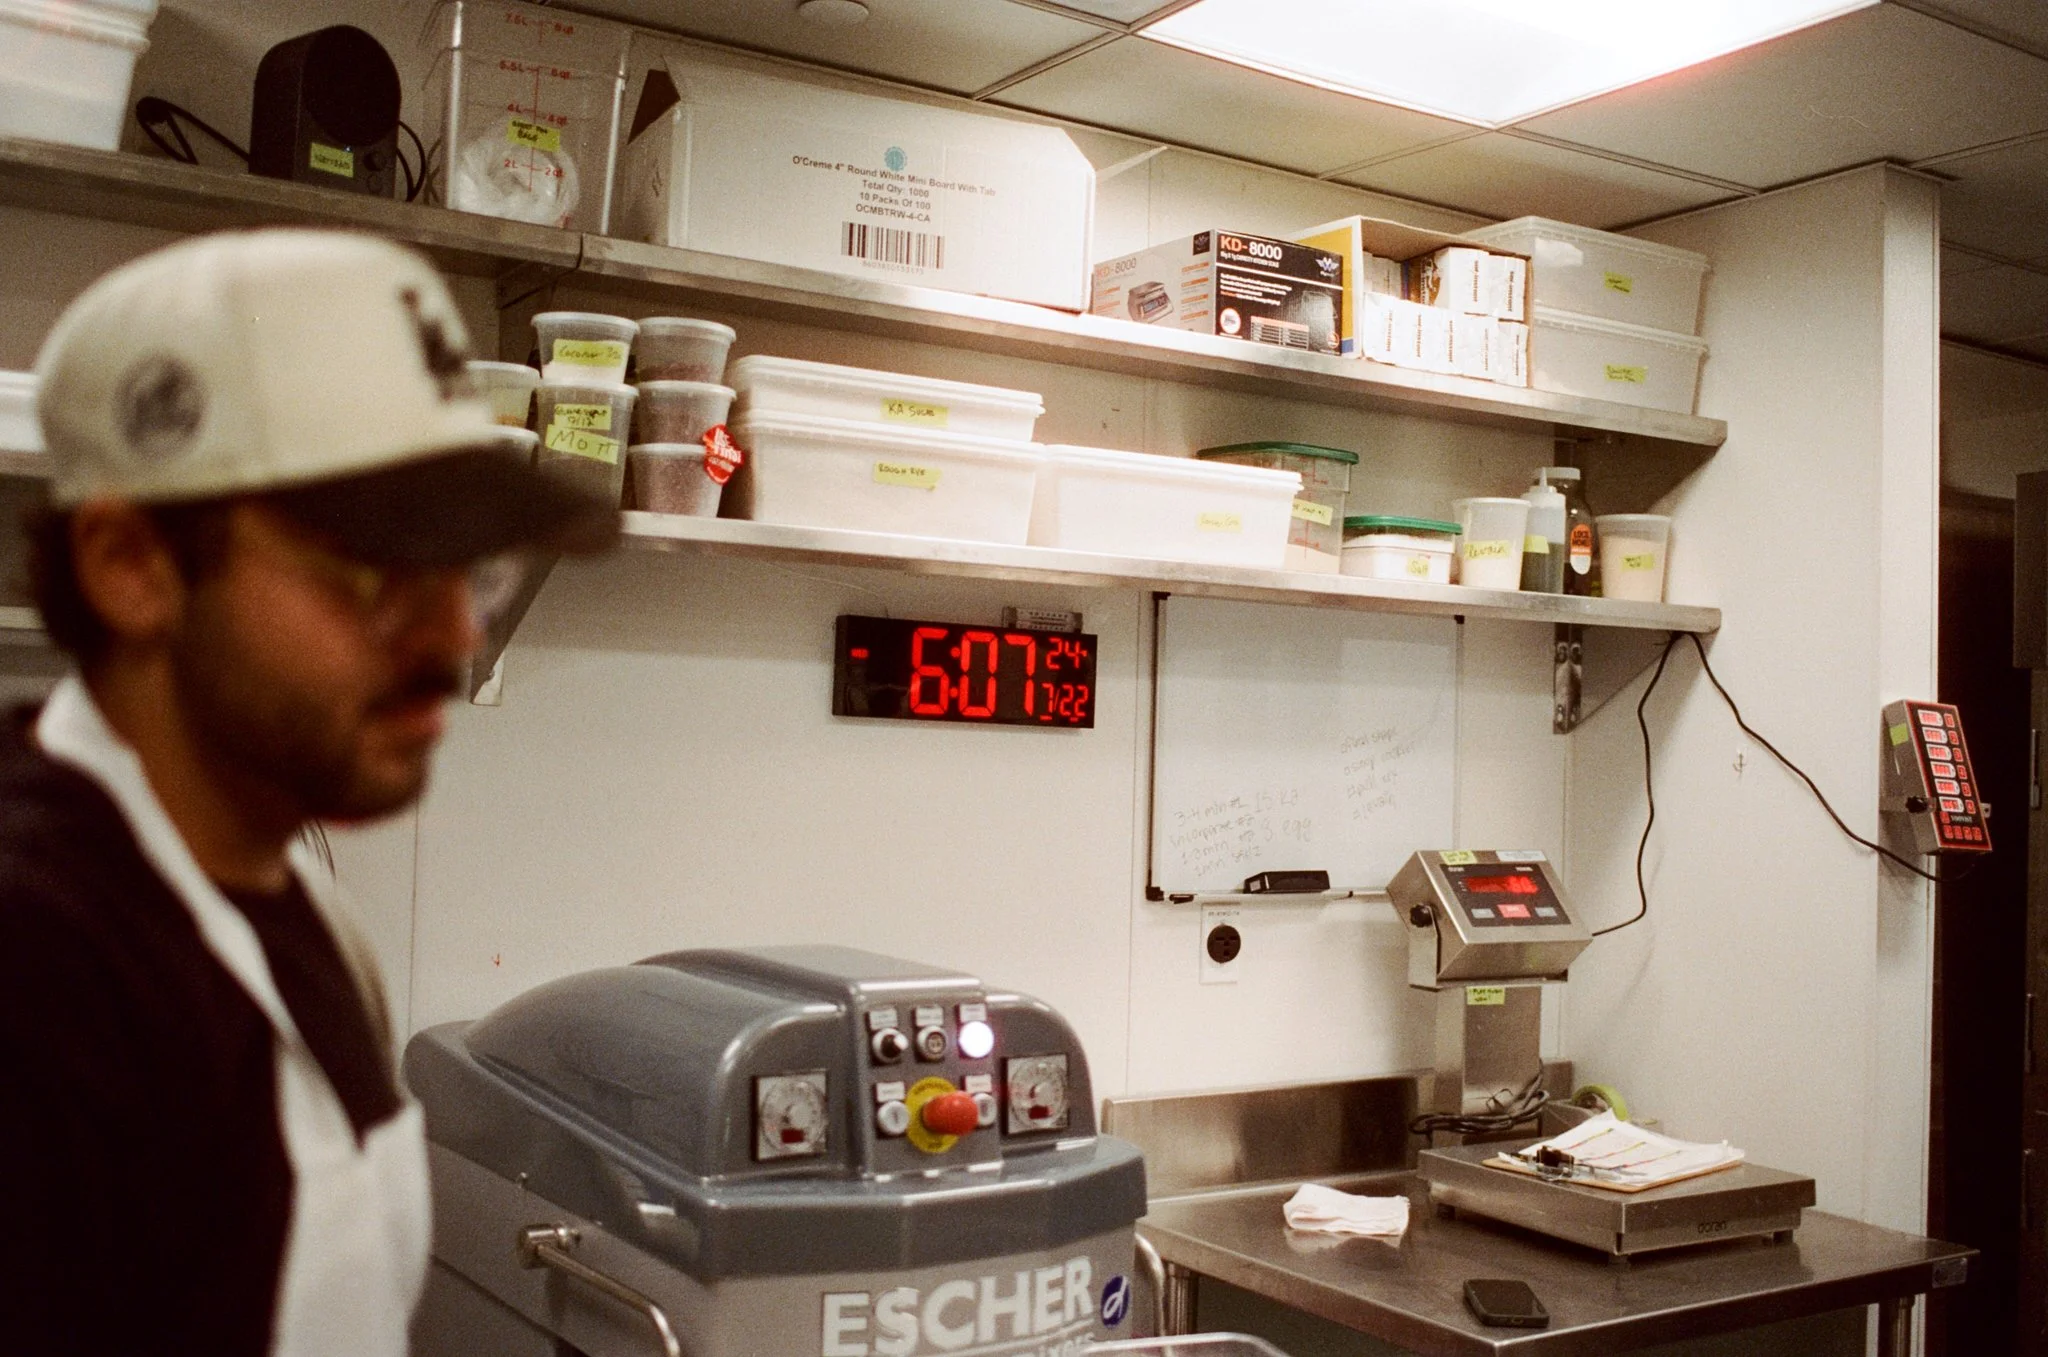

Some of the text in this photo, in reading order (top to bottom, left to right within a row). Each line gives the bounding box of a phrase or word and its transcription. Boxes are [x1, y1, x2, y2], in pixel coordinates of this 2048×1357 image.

[792, 154, 833, 170] O'Creme
[847, 165, 877, 178] Round
[879, 170, 905, 182] White
[908, 174, 926, 185] Mini
[929, 178, 956, 190] Board
[957, 183, 977, 194] With
[979, 186, 996, 197] Tab
[862, 180, 885, 191] Total
[908, 187, 930, 198] 1000
[860, 192, 931, 211] 10 Packs Of 100
[909, 627, 1035, 718] 6:07
[821, 1256, 1094, 1357] ESCHER
